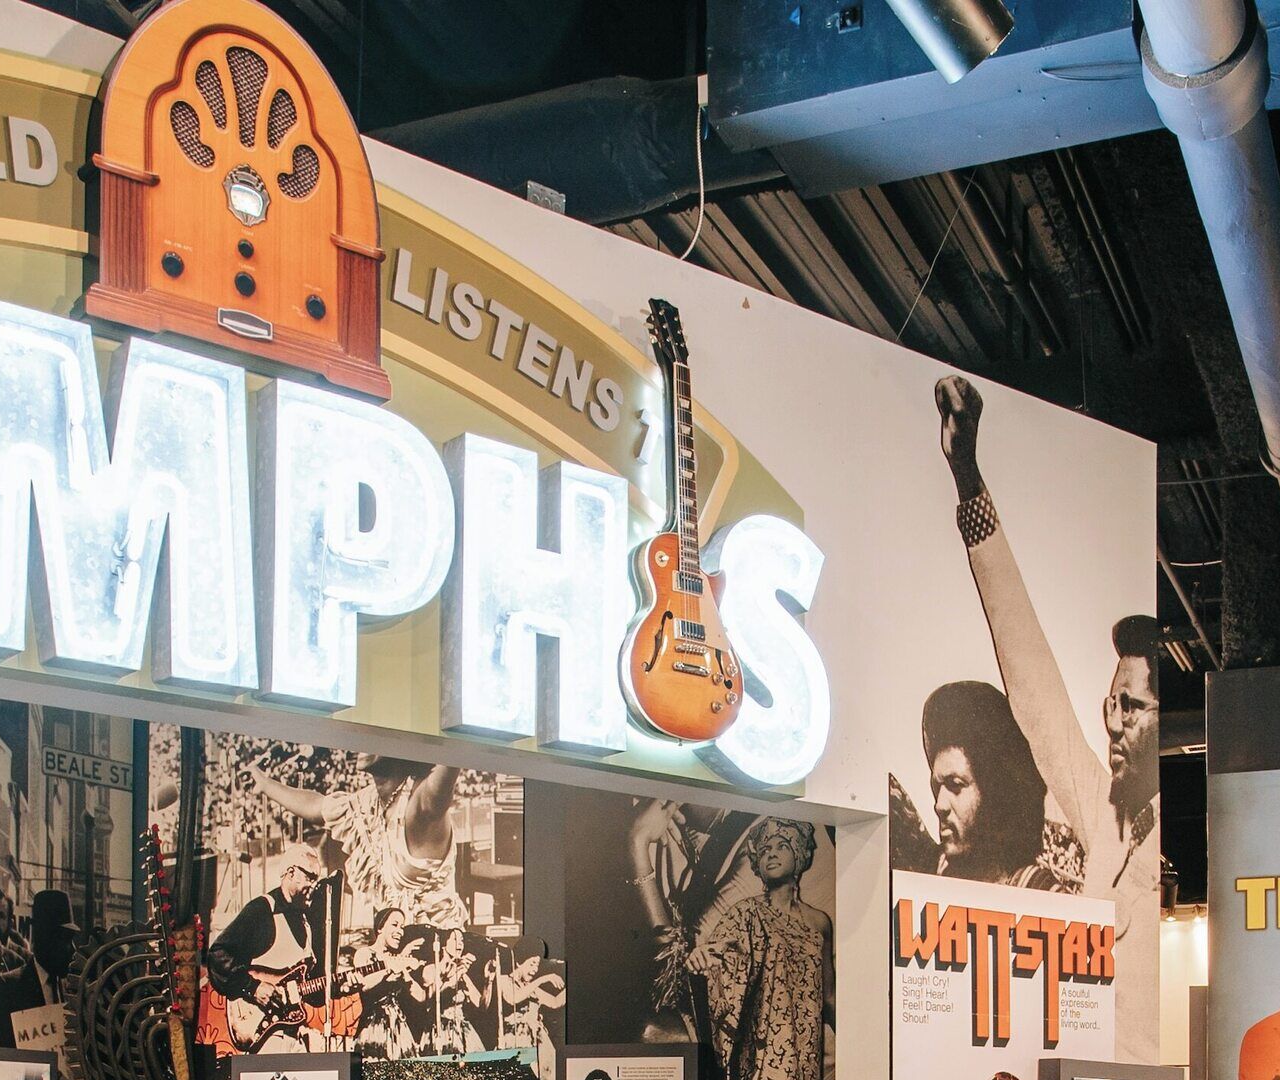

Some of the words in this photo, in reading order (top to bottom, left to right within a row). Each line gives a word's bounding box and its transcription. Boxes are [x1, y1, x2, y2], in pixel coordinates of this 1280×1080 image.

[389, 247, 625, 433] LISTENS
[45, 751, 102, 782] BEALE
[892, 898, 1115, 1050] WATTSTAX
[902, 973, 931, 987] Laugh!
[932, 975, 950, 988] Cry!
[902, 987, 923, 1000] Sing!
[925, 989, 948, 1000] Hear!
[902, 1000, 924, 1010] Feel!
[925, 1001, 954, 1013] Dance!
[1060, 999, 1099, 1009] expression
[902, 1012, 929, 1024] Shout!
[1069, 1010, 1081, 1019] the
[1060, 1019, 1078, 1030] living
[18, 1023, 57, 1042] MACE
